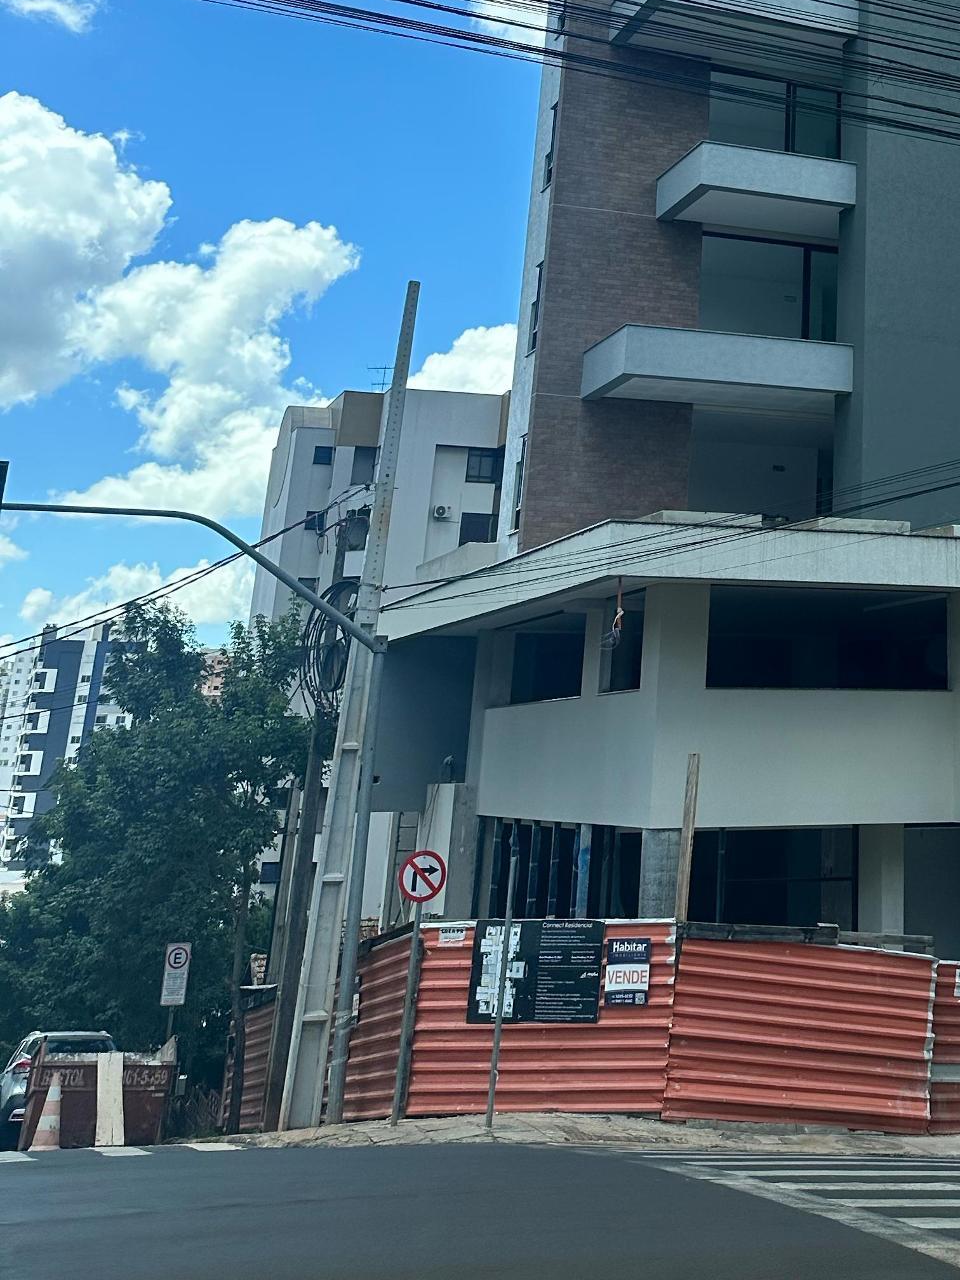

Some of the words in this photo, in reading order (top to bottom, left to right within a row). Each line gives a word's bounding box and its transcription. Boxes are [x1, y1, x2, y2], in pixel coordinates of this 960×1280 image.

[612, 941, 648, 953] Habitar
[173, 952, 183, 965] E
[607, 970, 648, 985] VENDE
